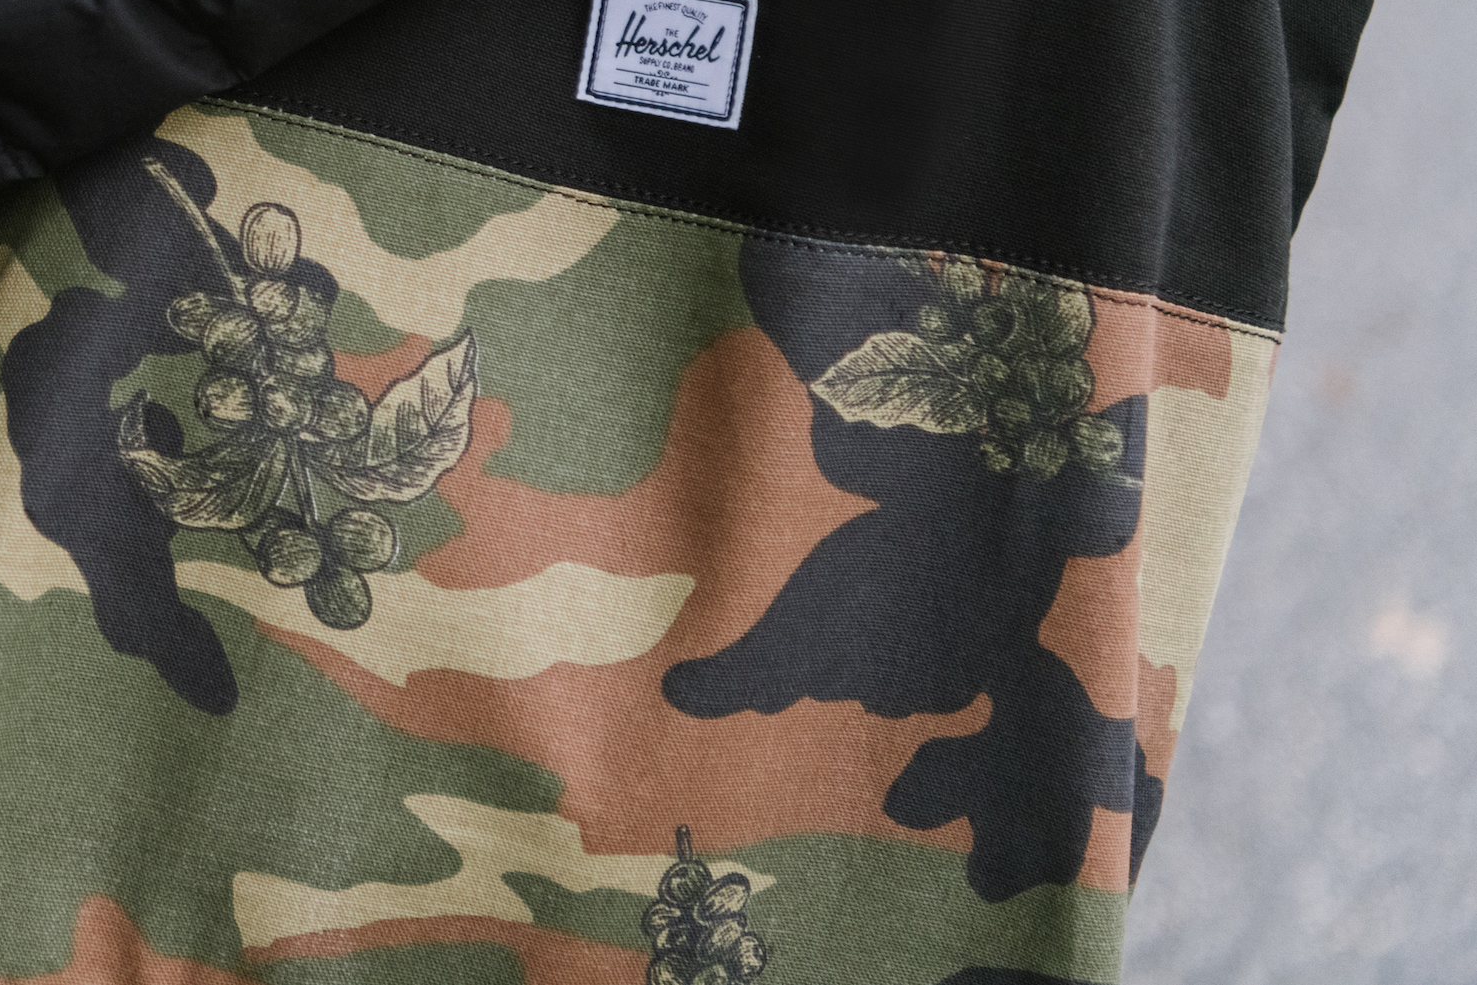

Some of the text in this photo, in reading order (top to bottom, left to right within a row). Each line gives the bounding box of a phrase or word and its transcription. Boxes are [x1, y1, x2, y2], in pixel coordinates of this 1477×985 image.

[644, 1, 708, 22] THE FINEST QUALITY
[615, 10, 725, 62] Herschel
[665, 28, 679, 38] THE
[639, 56, 662, 67] SUPPLY
[634, 75, 690, 93] TRADE MARK
